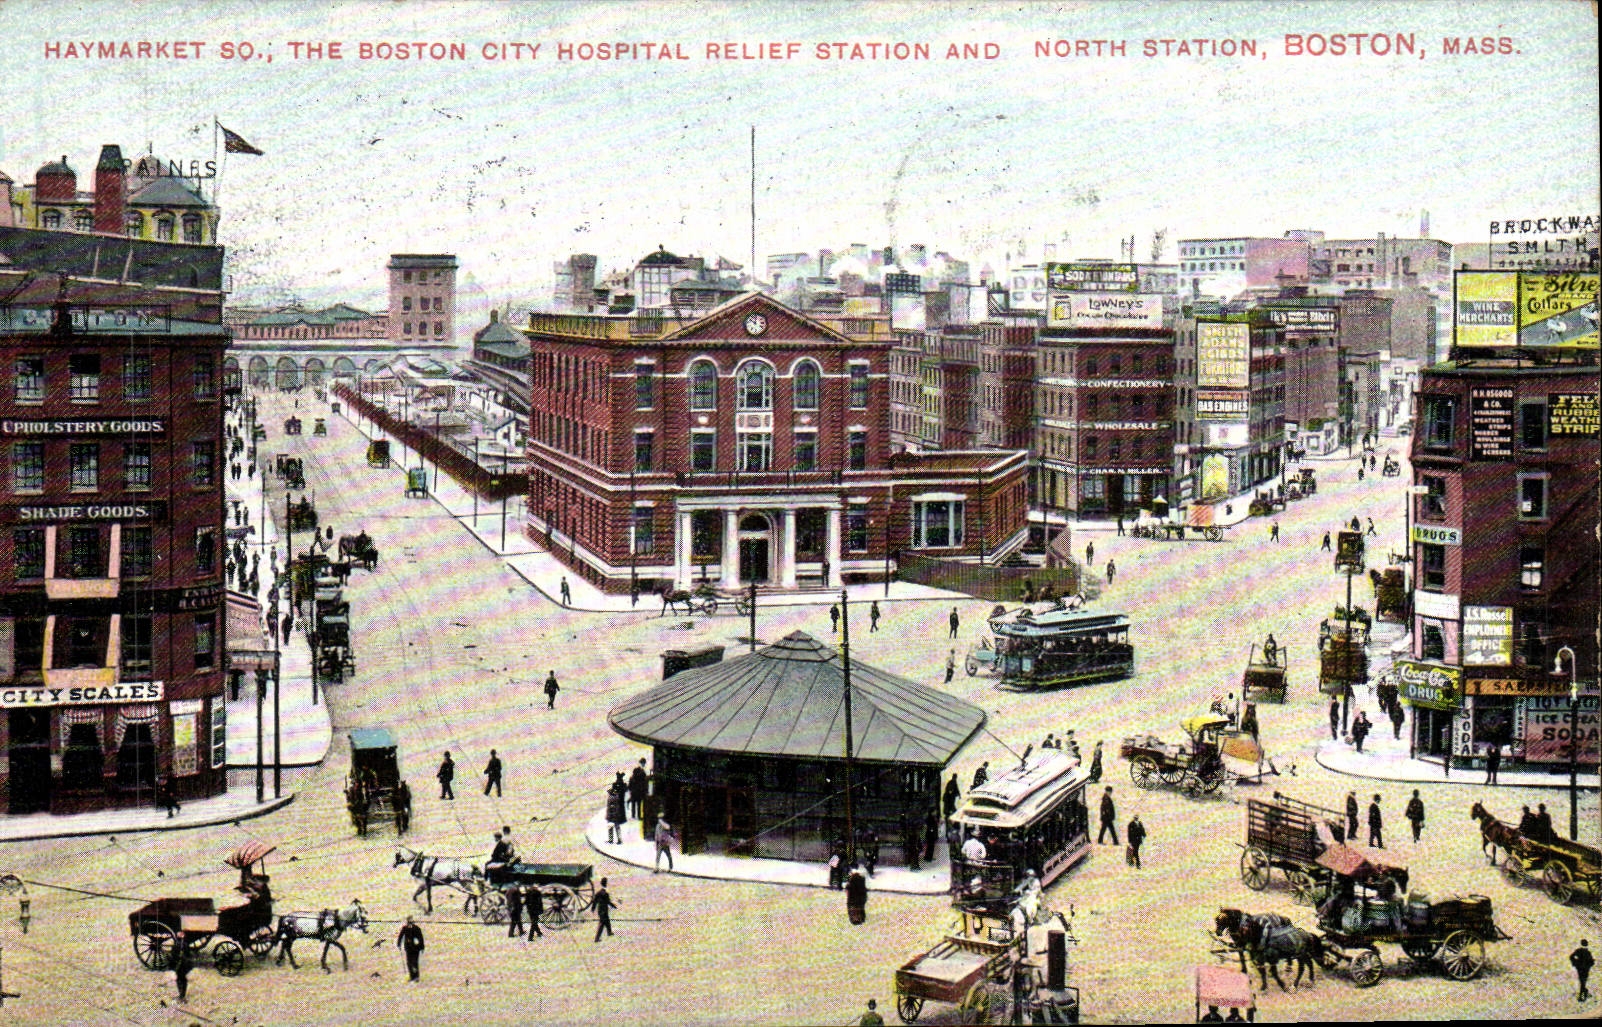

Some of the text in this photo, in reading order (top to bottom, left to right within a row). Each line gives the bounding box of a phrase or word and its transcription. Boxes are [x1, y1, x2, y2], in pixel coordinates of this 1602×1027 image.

[1527, 297, 1573, 315] Collars
[1459, 313, 1514, 324] MERCHANTS
[1087, 380, 1166, 388] CONFECTIONERY
[3, 421, 108, 434] UPHOLSTERY
[1093, 422, 1159, 431] WHOLESALE
[21, 506, 82, 519] SHADE
[2, 687, 62, 704] CITY
